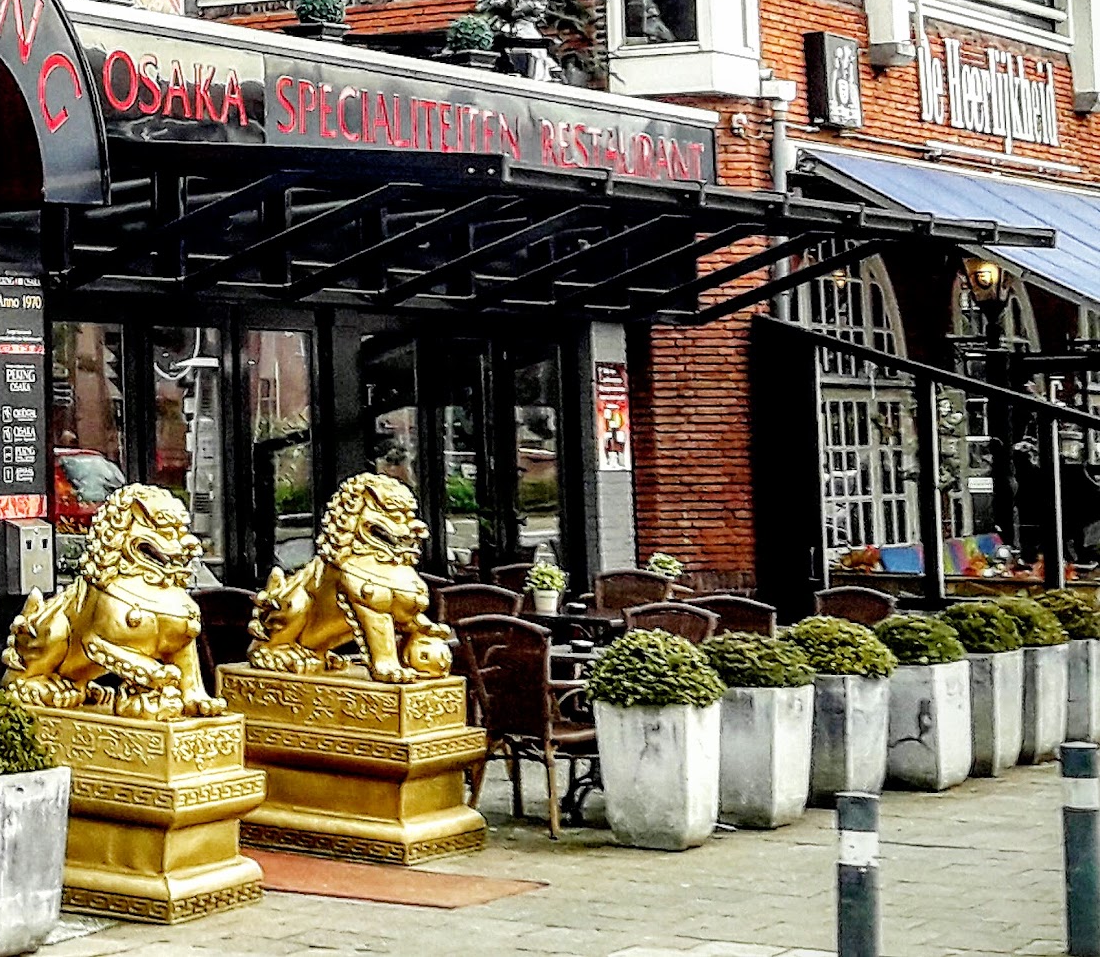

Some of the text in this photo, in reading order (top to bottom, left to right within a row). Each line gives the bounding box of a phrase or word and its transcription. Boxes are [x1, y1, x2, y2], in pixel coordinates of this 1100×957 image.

[103, 49, 705, 181] OSAKA SPECIALITEITEN RESTAURANT
[916, 37, 1060, 155] De Heerlijkheid
[22, 294, 43, 310] 1970
